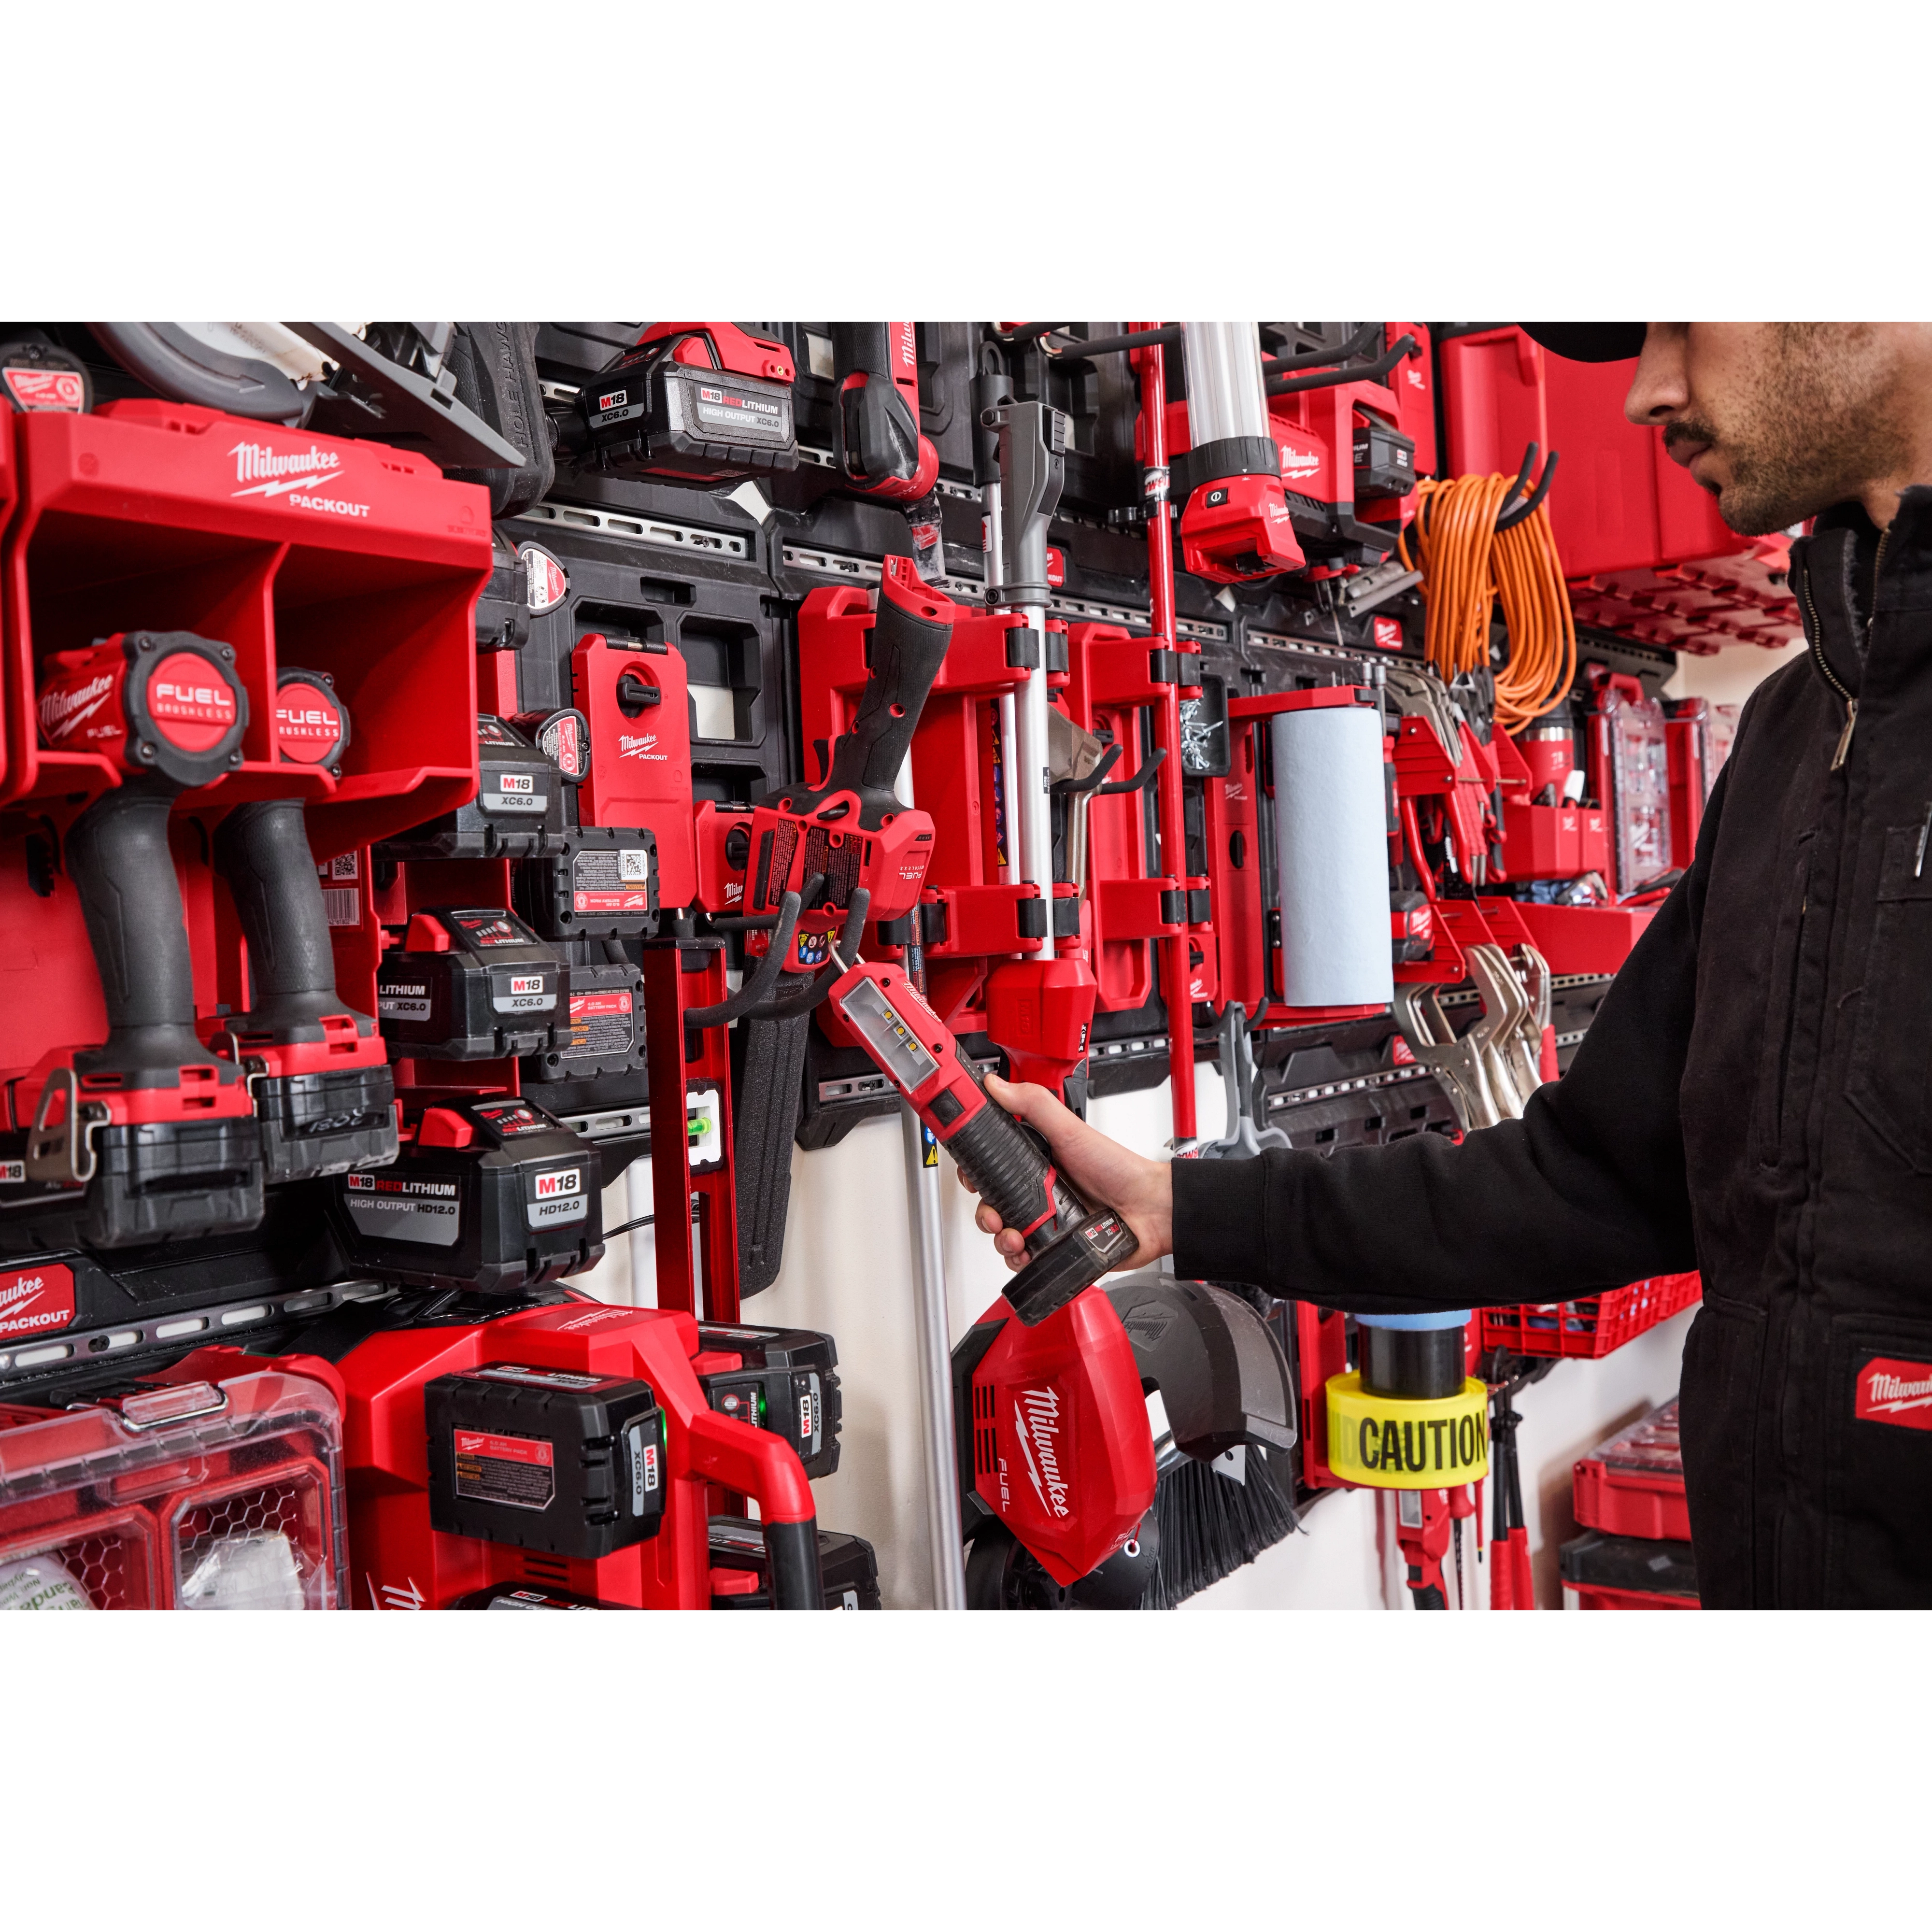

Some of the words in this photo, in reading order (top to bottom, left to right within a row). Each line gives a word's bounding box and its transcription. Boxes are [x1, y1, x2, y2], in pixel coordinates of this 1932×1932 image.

[601, 393, 625, 408] M18
[702, 390, 721, 400] M18
[723, 396, 778, 414] REDLITHIUM
[507, 389, 529, 448] HOLE
[601, 409, 629, 423] XC6.0
[703, 407, 723, 417] HIGH
[724, 411, 755, 423] OUTPUT
[756, 418, 779, 427] XC6.0
[227, 441, 341, 483] Milwaukee
[1280, 445, 1319, 469] Milwaukee
[289, 494, 370, 517] PACKOUT
[550, 566, 559, 596] Milwaukee
[40, 674, 114, 725] Milwaukee
[156, 684, 231, 706] FUEL
[157, 703, 232, 720] BRUSHLESS
[279, 726, 338, 737] RUSHLESS
[566, 723, 575, 752] Milwaukee
[618, 733, 657, 752] Milwaukee
[503, 778, 530, 789] M18
[501, 797, 532, 805] XC6.0
[624, 897, 643, 908] Milwaukee
[379, 985, 426, 995] LITHIUM
[513, 980, 540, 991] M18
[378, 1001, 395, 1010] PUT
[397, 1002, 426, 1011] XC6.0
[511, 998, 543, 1007] XC6.0
[903, 980, 942, 1023] Milwaukee
[349, 1176, 373, 1187] M18
[376, 1180, 455, 1196] REDLITHIUM
[539, 1174, 577, 1195] M18
[350, 1199, 373, 1208] HIGH
[376, 1201, 416, 1212] OUTPUT
[417, 1204, 455, 1215] HD12.0
[539, 1201, 580, 1216] HD12.0
[1087, 1230, 1096, 1238] M12
[0, 1277, 44, 1307] aukee
[0, 1309, 70, 1333] PACKOUT
[1867, 1372, 1932, 1403] Milwau
[461, 1437, 484, 1447] Milwaukee
[1360, 1409, 1486, 1472] CAUTION
[1021, 1386, 1069, 1518] Milwaukee
[634, 1450, 642, 1495] XC6.0
[646, 1448, 655, 1487] M18
[998, 1458, 1010, 1512] FUEL
[495, 1598, 525, 1607] HIGH
[515, 1591, 543, 1601] M18
